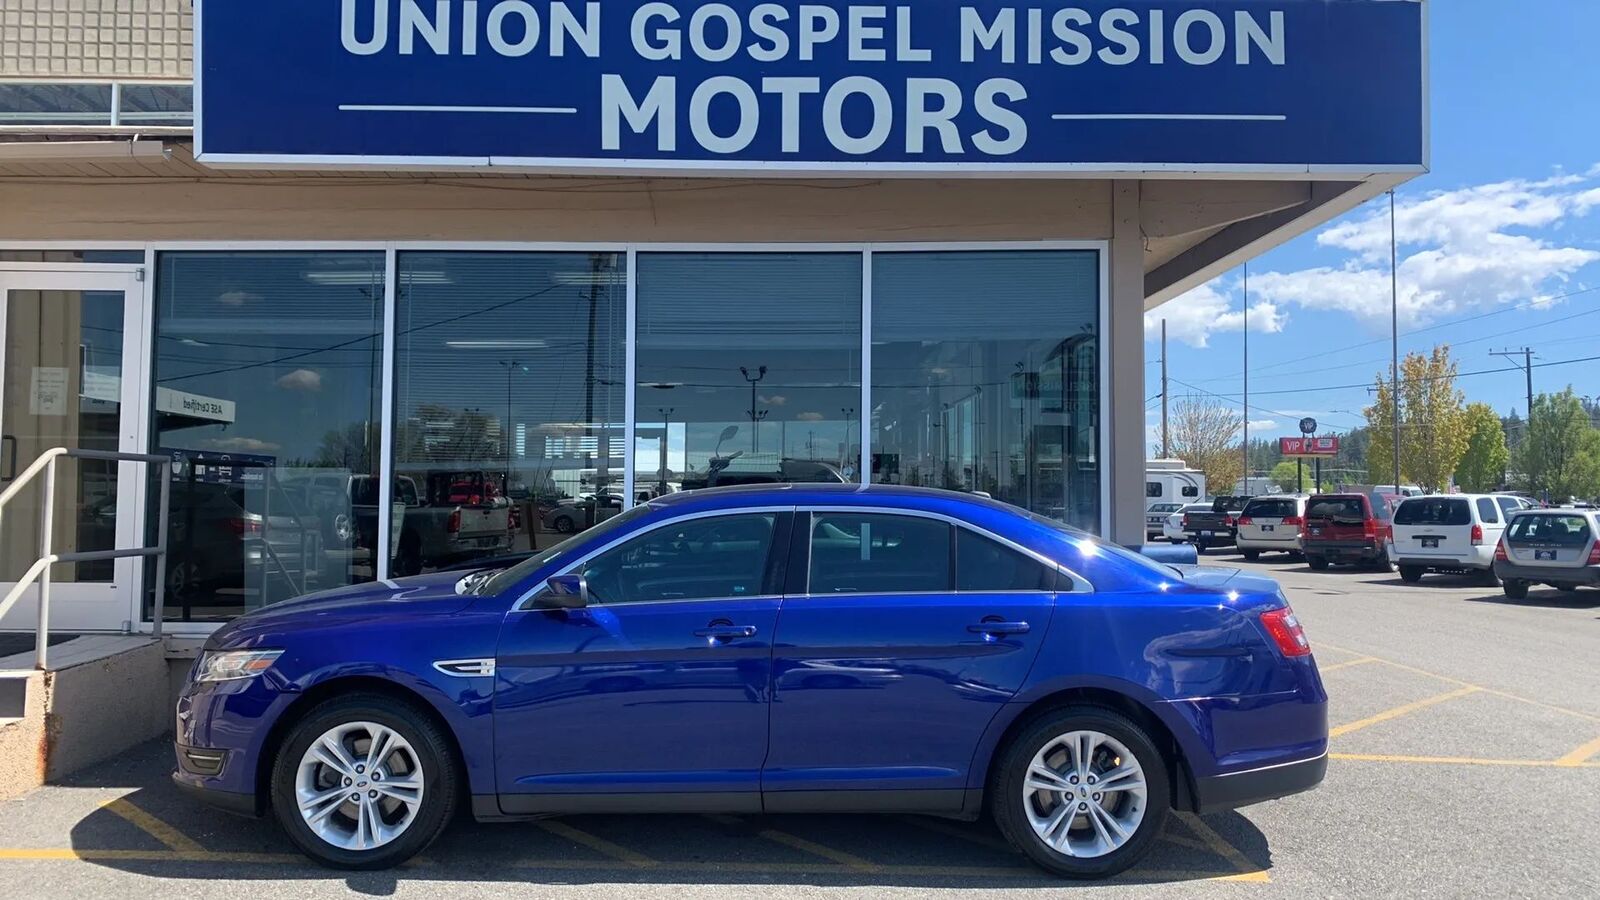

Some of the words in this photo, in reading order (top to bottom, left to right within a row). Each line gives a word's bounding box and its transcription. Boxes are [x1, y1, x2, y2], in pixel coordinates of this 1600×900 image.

[341, 0, 600, 57] UNION
[631, 2, 932, 62] GOSPEL
[961, 7, 1286, 66] MISSION
[601, 74, 1028, 155] MOTORS
[1304, 422, 1314, 430] VIP
[1287, 441, 1300, 451] VIP
